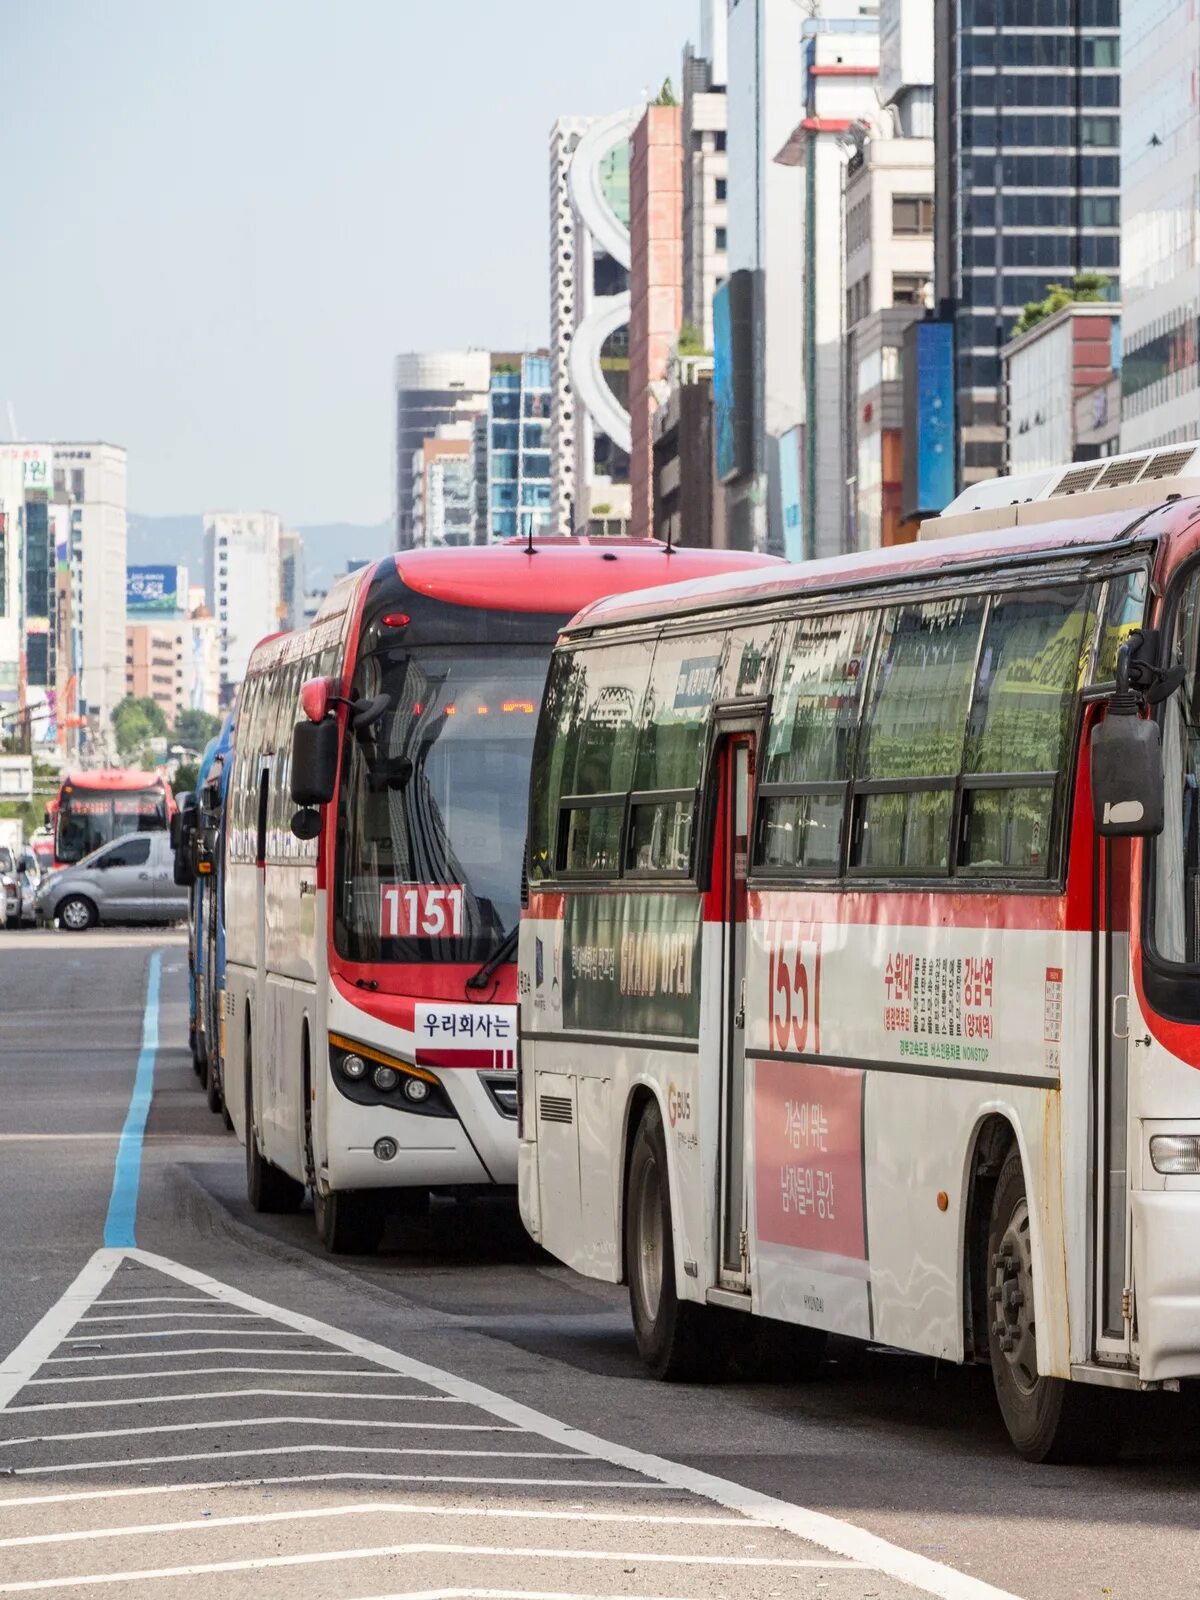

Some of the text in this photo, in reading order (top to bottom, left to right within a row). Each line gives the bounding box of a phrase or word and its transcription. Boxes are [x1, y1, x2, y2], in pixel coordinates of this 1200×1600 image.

[384, 889, 462, 936] 1151
[884, 952, 914, 1002] 수원대
[964, 956, 994, 1007] 강남역
[423, 1013, 511, 1038] 우리회사는
[784, 1099, 809, 1149] 가슴이
[780, 1164, 835, 1220] 남자들의 공간
